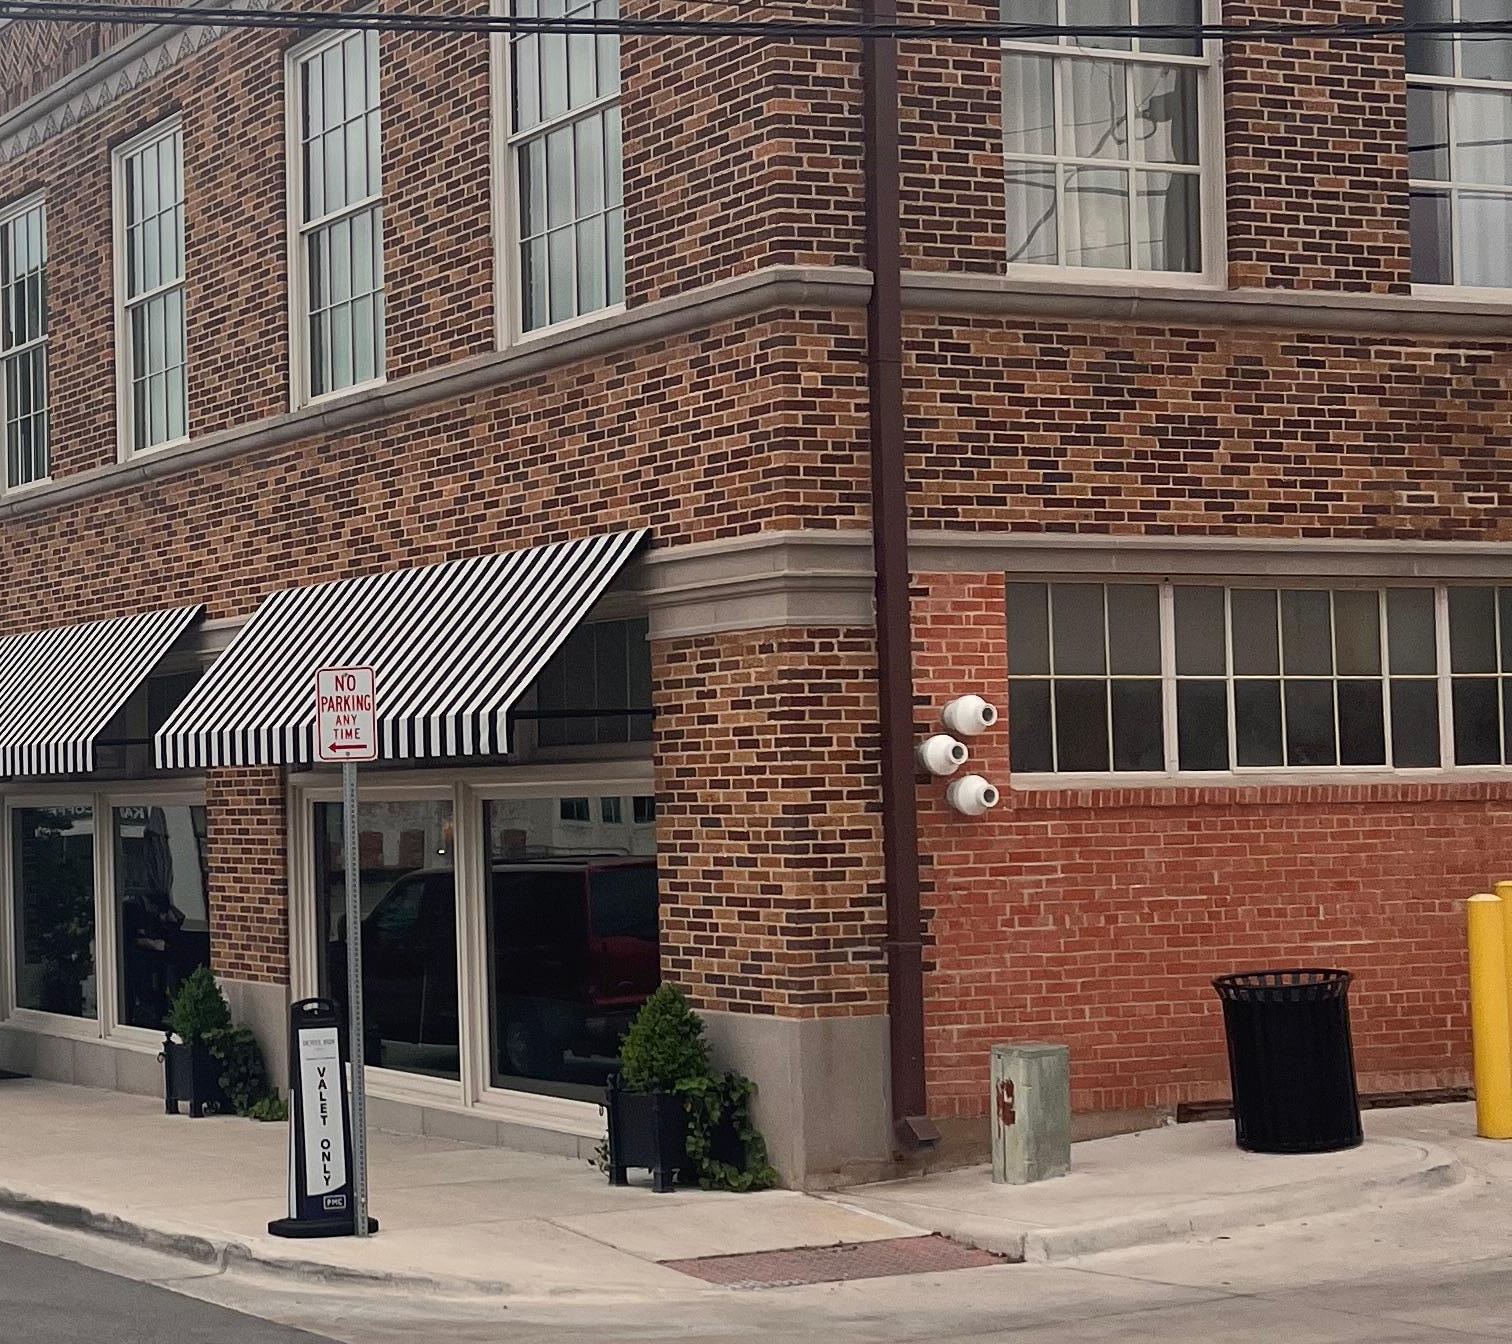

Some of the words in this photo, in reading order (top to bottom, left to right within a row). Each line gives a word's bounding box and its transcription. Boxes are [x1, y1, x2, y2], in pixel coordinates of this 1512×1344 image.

[335, 674, 356, 692] NO
[321, 694, 371, 712] PARKING
[335, 714, 357, 726] ANY
[333, 728, 361, 740] TIME
[317, 1066, 328, 1126] VALET
[320, 1139, 331, 1186] ONLY
